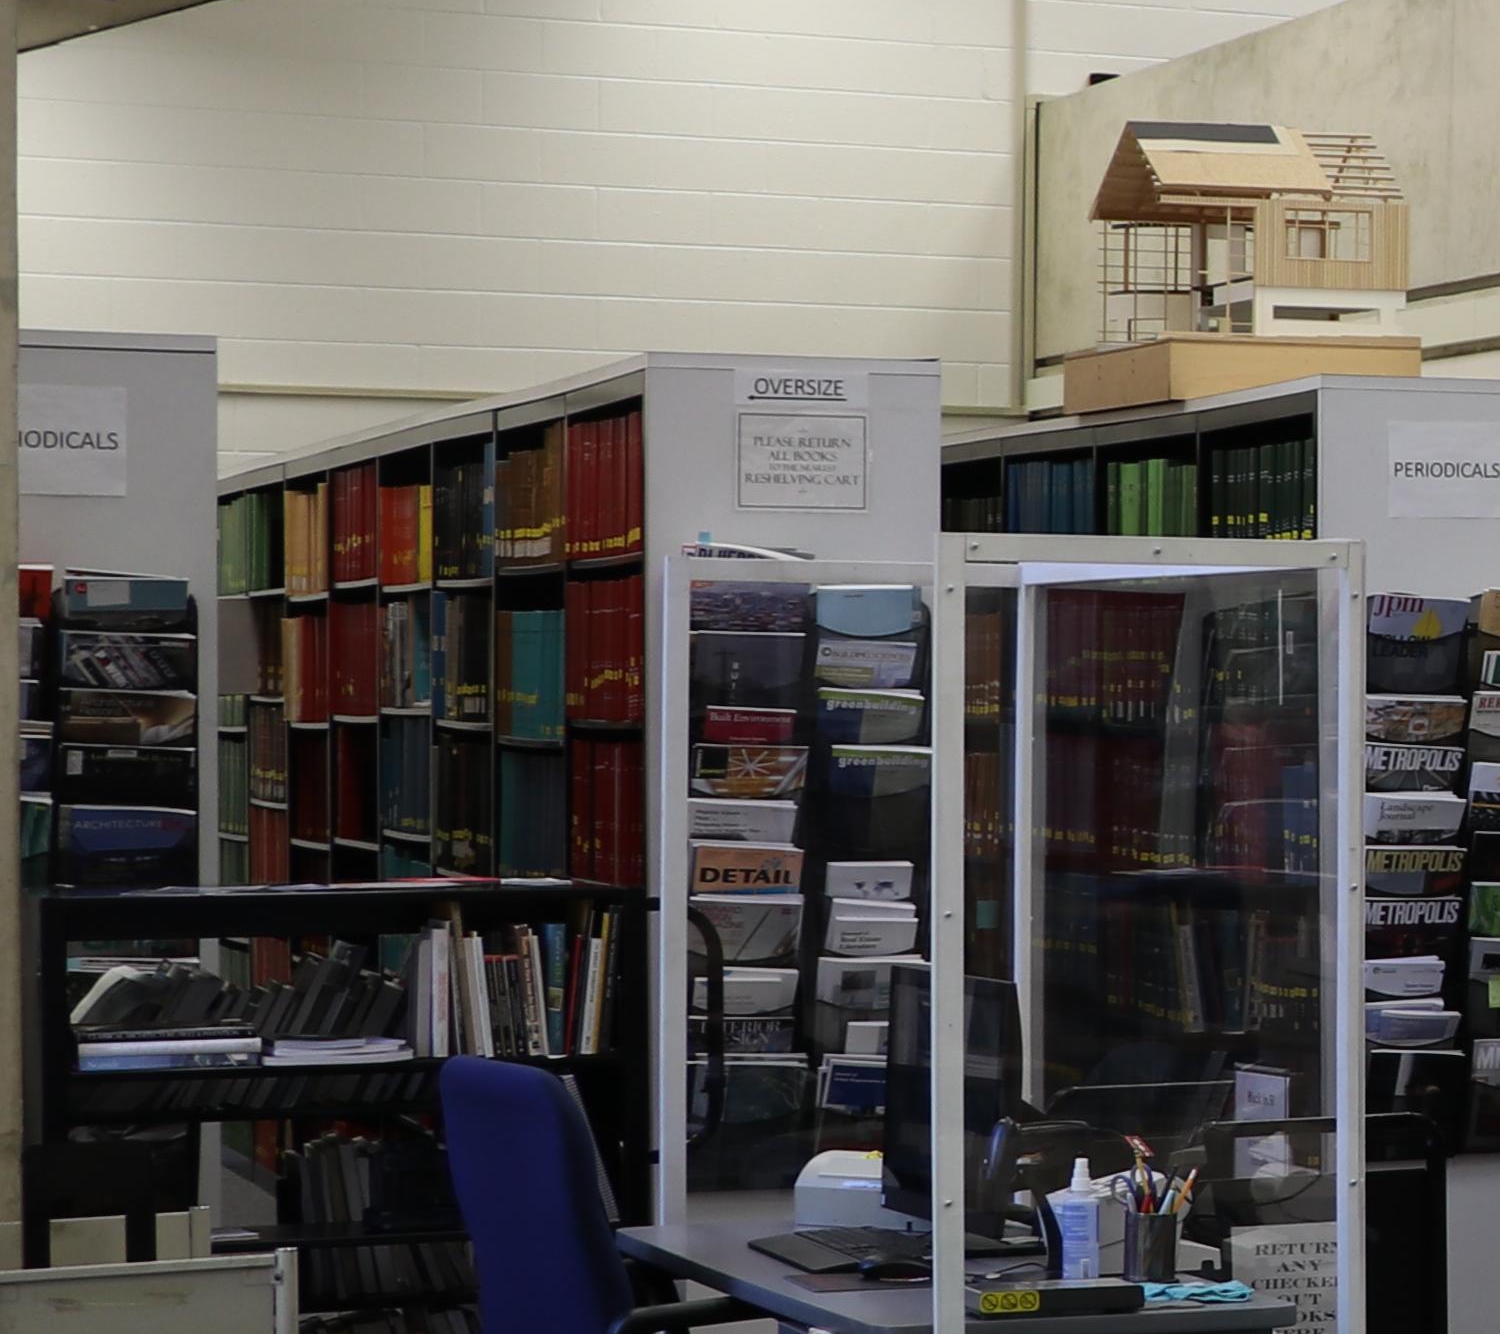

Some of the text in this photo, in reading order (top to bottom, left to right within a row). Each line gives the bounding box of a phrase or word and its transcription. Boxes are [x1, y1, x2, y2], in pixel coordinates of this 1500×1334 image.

[753, 377, 844, 397] OVERSIZE
[18, 430, 119, 451] IODICALS
[752, 435, 852, 449] PLEASE RETURN
[769, 450, 839, 462] ALL BOOKS
[1393, 461, 1500, 479] PERIODICALS
[744, 472, 860, 486] RESHELVING CART
[825, 699, 918, 716] greenbuilding
[1364, 746, 1463, 771] METROPOLIS
[1380, 802, 1433, 814] Landscape
[74, 818, 161, 830] ARCHITECTURE
[1367, 849, 1464, 873] METROPOLIS
[700, 867, 793, 885] DETAIL
[1364, 900, 1459, 925] METROPOLIS
[1276, 1259, 1321, 1273] ANY
[1251, 1276, 1337, 1290] CHECKE
